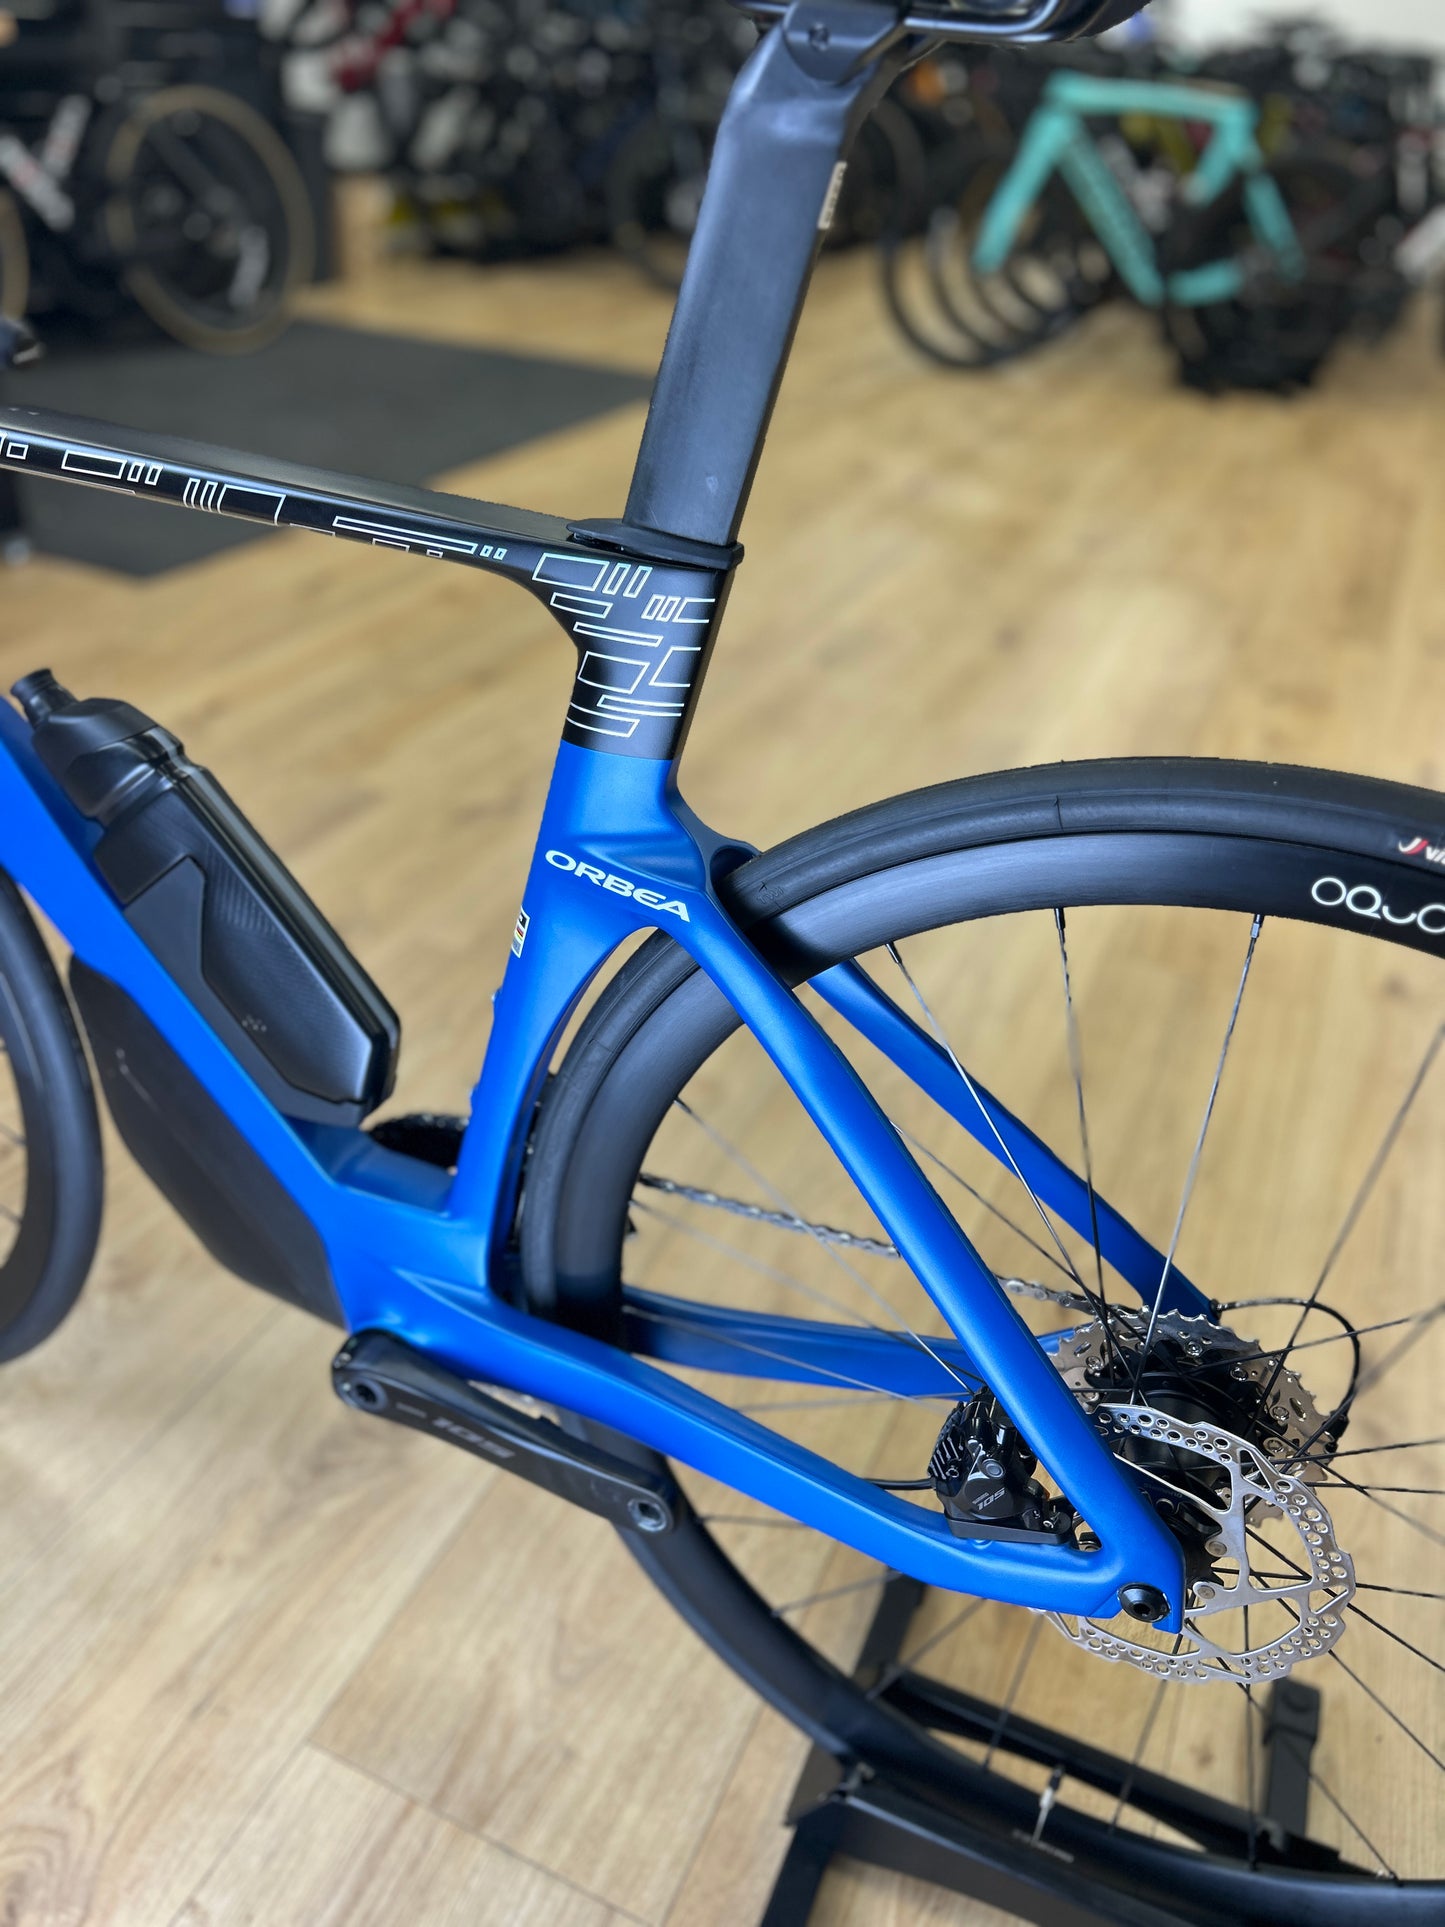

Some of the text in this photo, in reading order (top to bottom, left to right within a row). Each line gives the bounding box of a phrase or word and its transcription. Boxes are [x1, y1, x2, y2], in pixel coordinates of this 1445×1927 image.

[545, 850, 690, 922] ORBEA
[1311, 877, 1445, 933] OQUO
[976, 1487, 1006, 1511] 105
